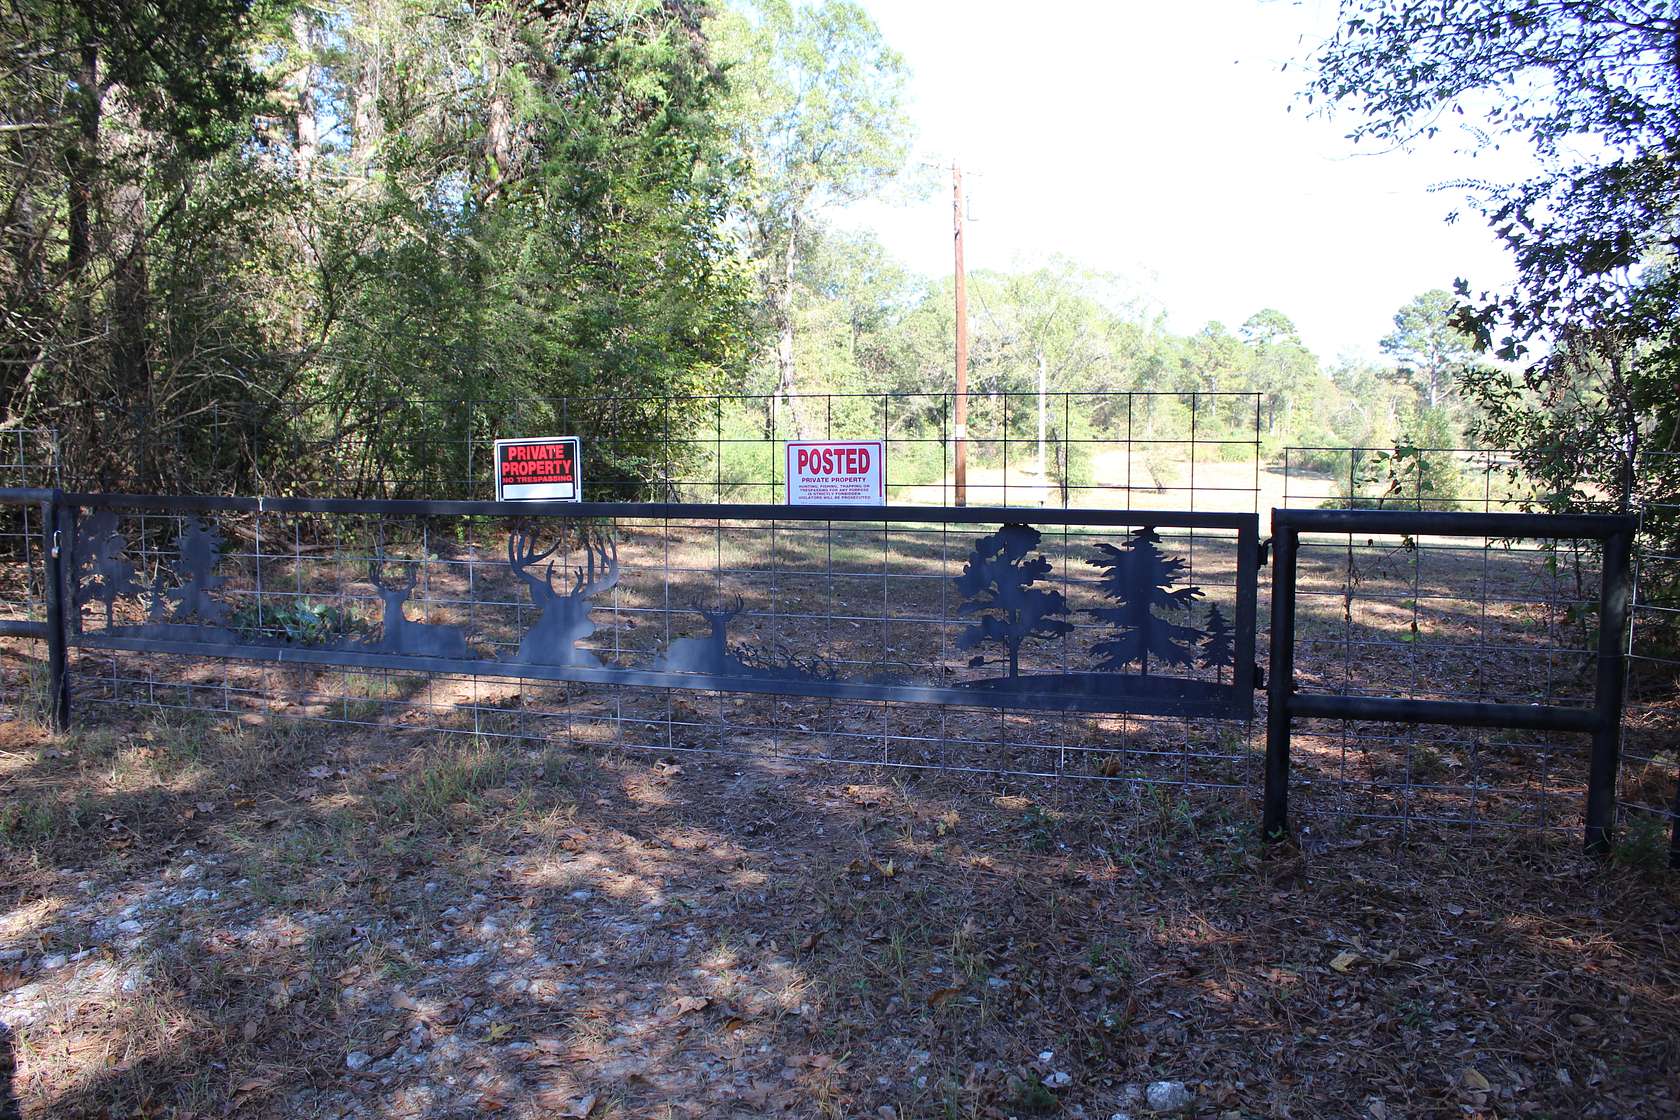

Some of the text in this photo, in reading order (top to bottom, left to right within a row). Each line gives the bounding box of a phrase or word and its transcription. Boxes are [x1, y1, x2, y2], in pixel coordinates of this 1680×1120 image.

[508, 445, 564, 460] PRIVATE
[502, 460, 572, 475] PROPERTY
[798, 448, 870, 475] POSTED
